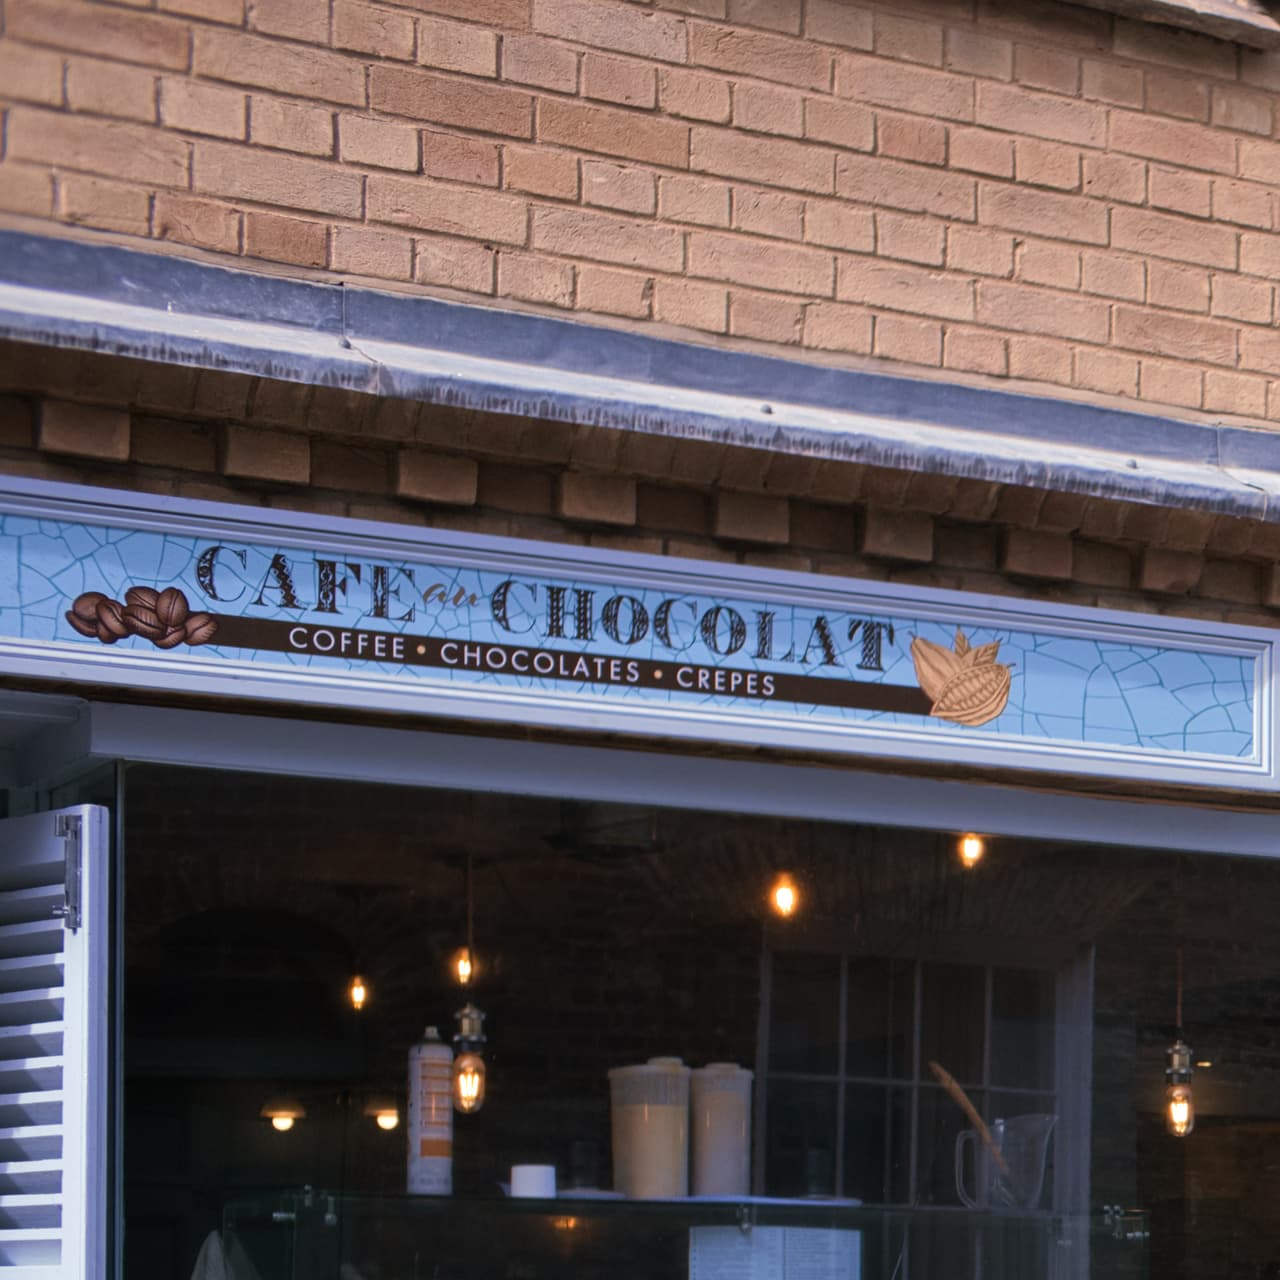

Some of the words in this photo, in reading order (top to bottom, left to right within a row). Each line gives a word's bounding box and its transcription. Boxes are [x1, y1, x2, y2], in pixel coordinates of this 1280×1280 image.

[194, 545, 416, 623] CAFE
[491, 579, 895, 672] CHOCOLAT
[288, 627, 405, 659] COFFEE
[440, 642, 640, 682] CHOCOLATES
[676, 666, 776, 696] CREPES
